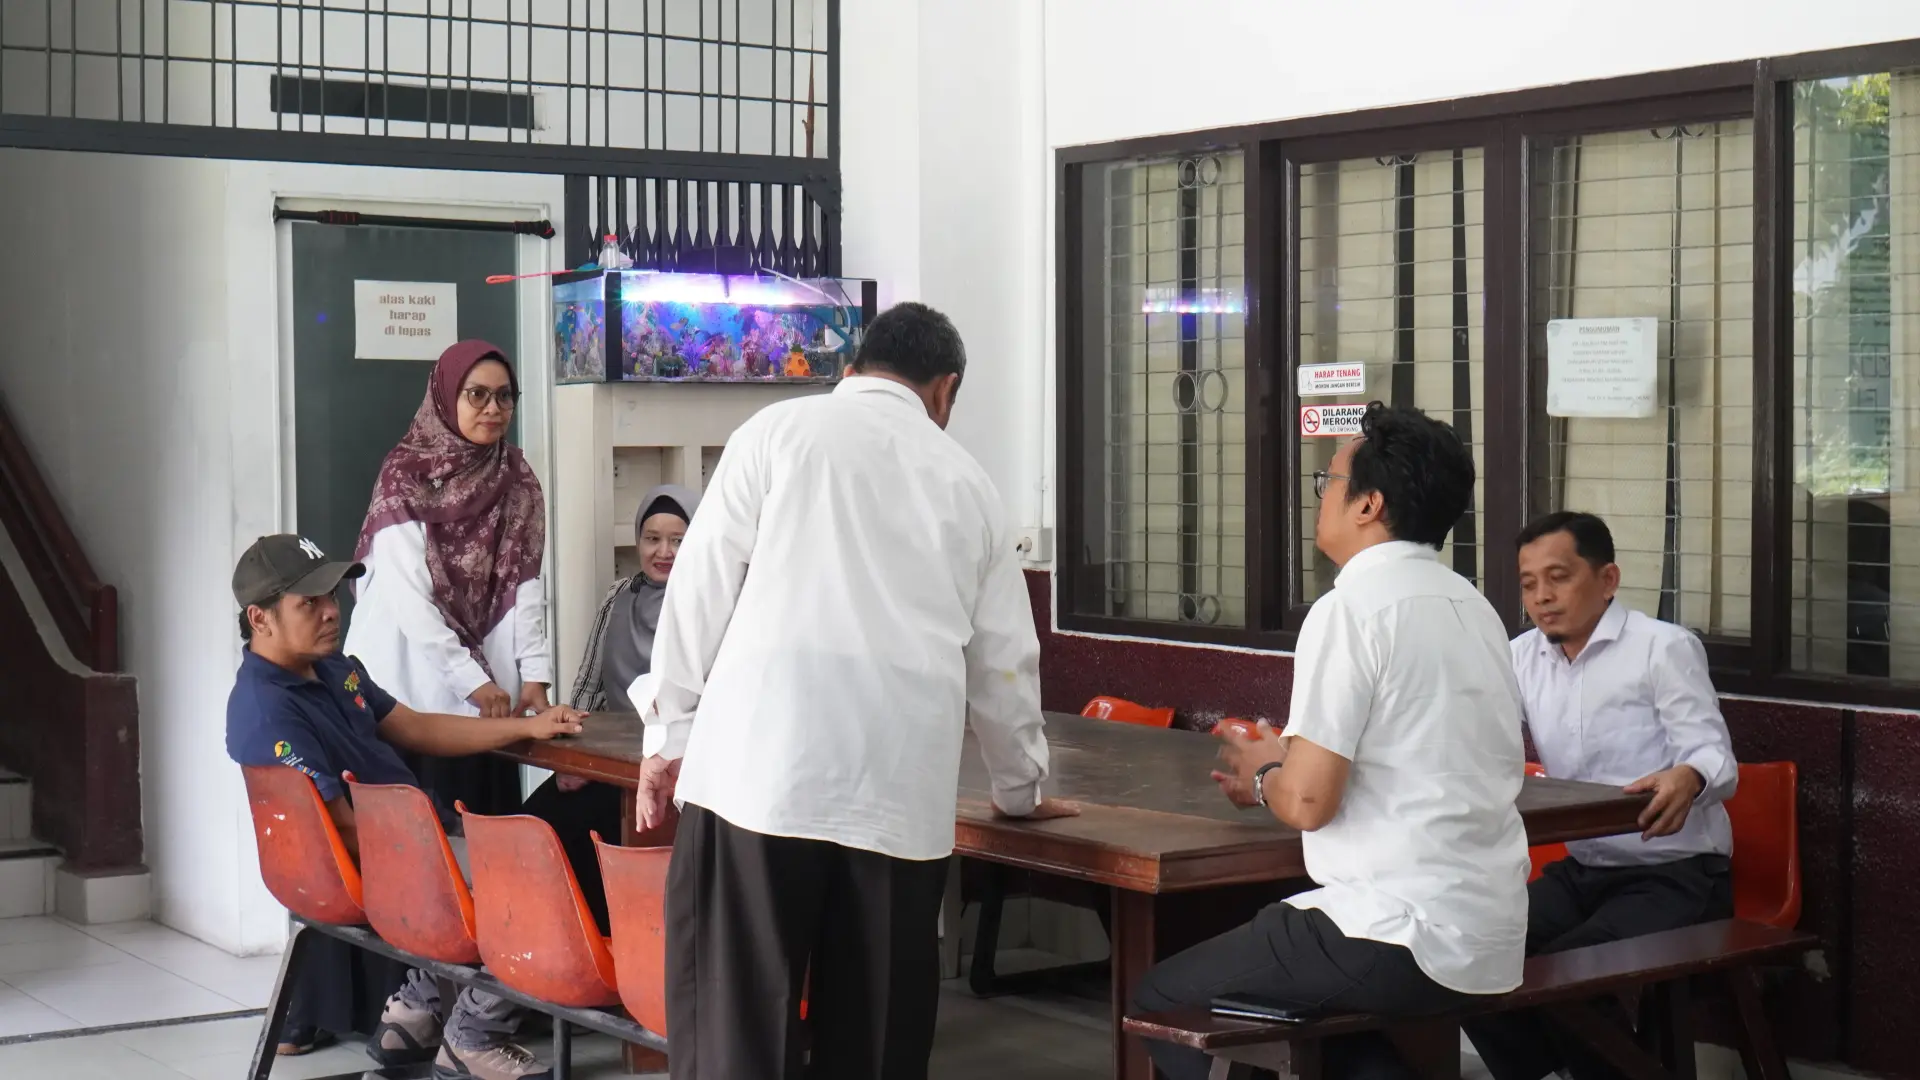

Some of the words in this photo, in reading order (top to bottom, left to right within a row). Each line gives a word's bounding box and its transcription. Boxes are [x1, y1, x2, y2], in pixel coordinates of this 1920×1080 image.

[379, 294, 405, 304] alas
[408, 295, 436, 305] kaki
[389, 309, 426, 321] harap
[384, 325, 395, 335] di
[399, 325, 431, 336] lepas
[1314, 370, 1334, 378] HARAP
[1336, 369, 1360, 378] TENANG
[1322, 408, 1364, 417] DILARANG
